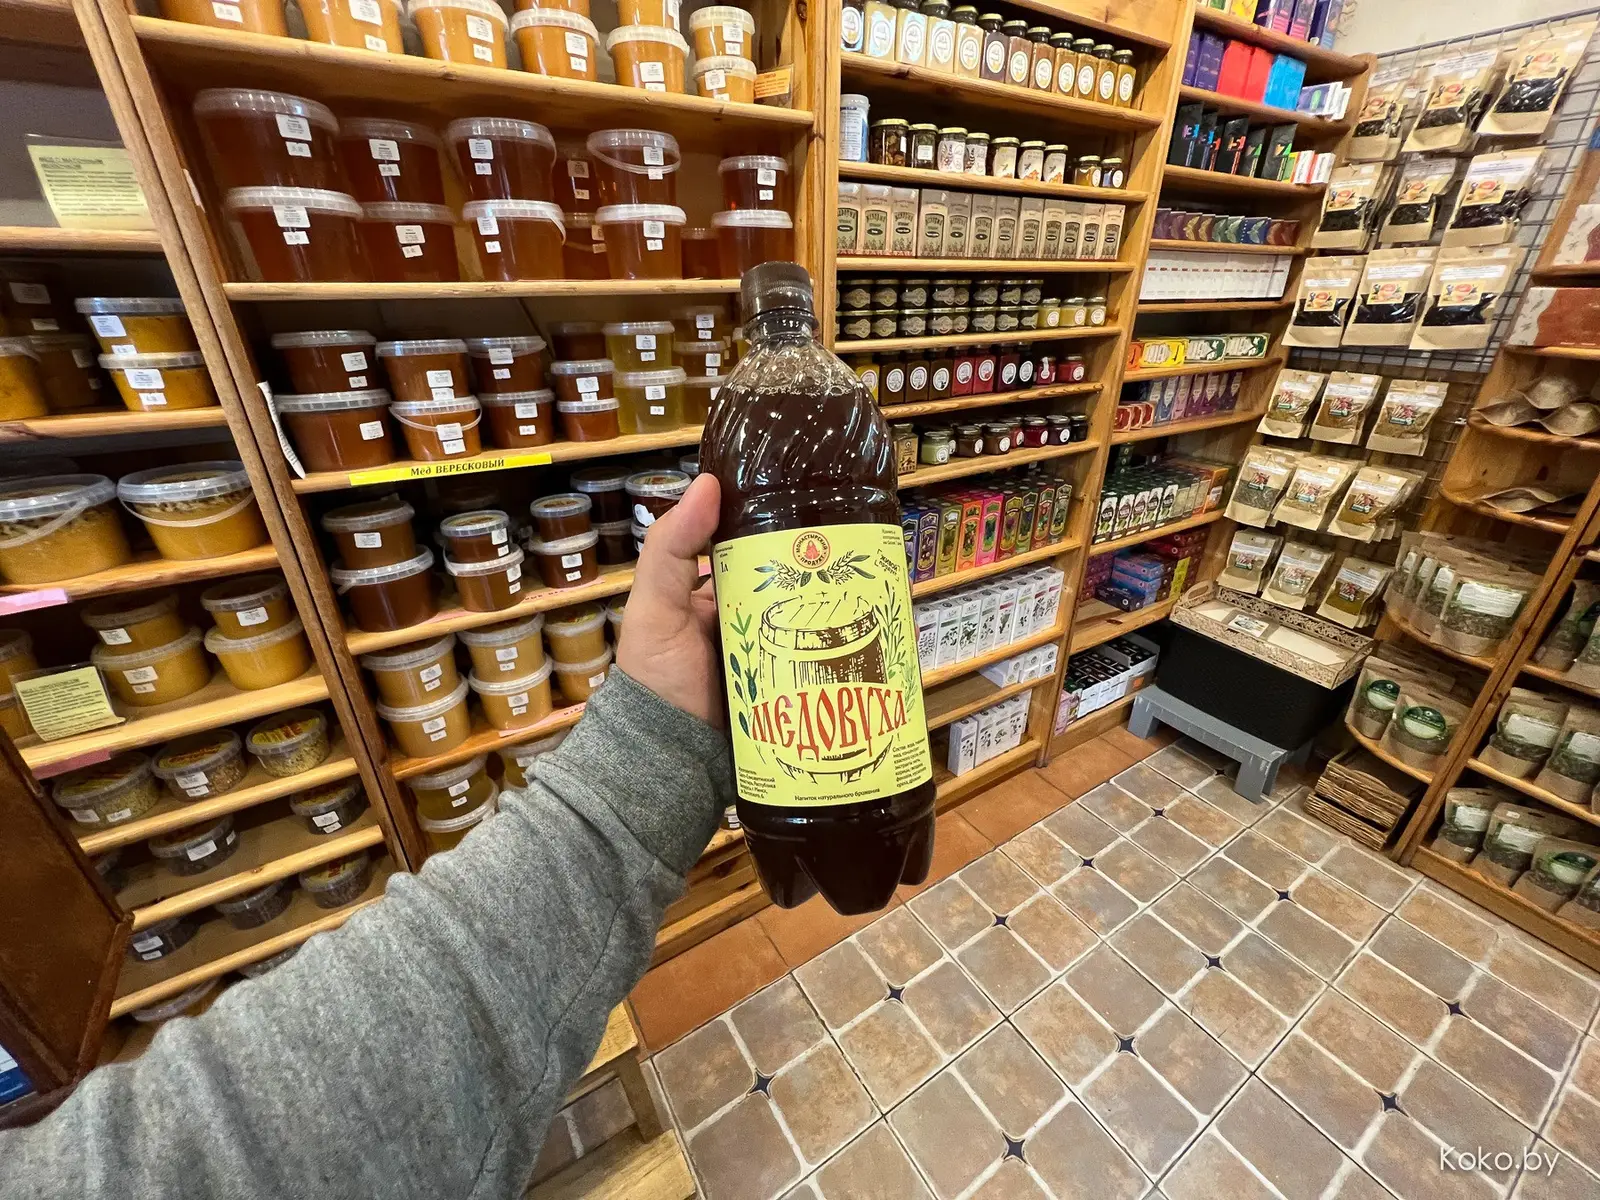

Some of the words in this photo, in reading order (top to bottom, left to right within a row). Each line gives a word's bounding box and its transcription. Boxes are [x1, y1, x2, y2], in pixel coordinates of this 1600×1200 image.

[435, 459, 505, 474] ВЕРЕСКОВЫЙ
[796, 534, 828, 553] МОНАСТЫРСКИЙ
[800, 554, 825, 567] ПРОДУКТ
[752, 686, 908, 763] МЕДОВУХА
